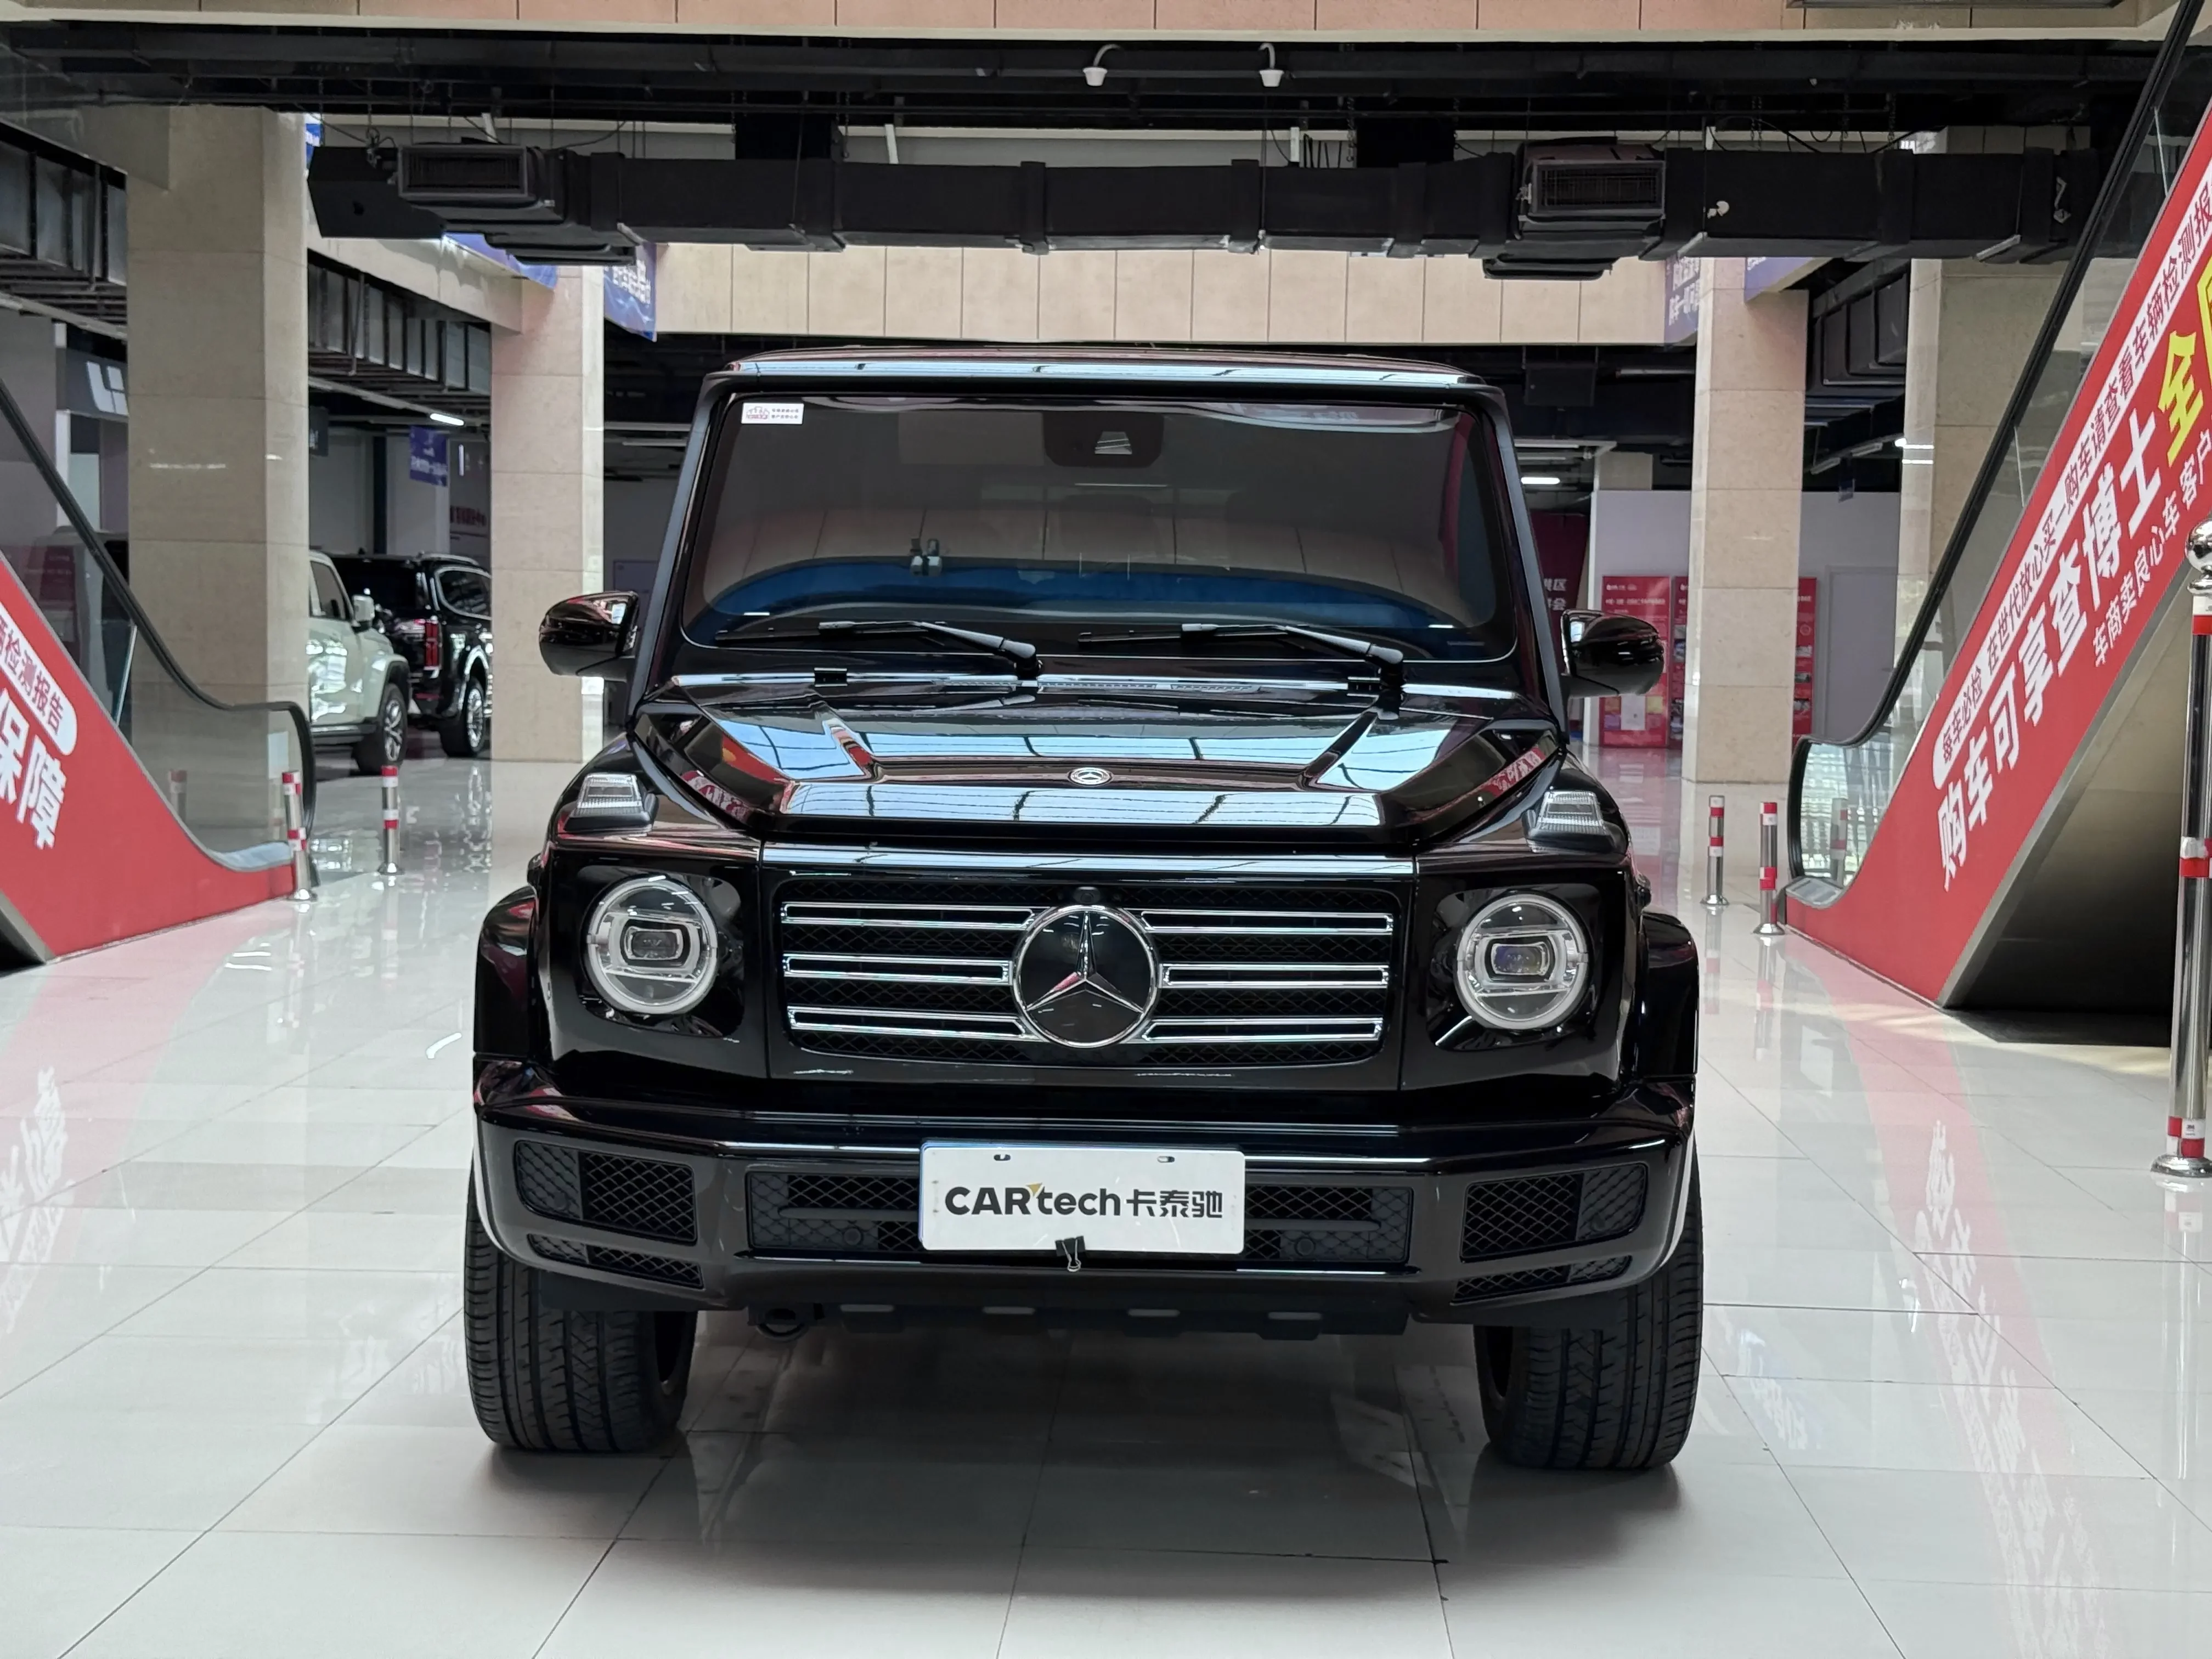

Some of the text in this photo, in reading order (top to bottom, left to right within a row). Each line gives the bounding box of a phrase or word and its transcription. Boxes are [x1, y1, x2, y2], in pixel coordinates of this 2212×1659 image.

[1937, 257, 2212, 891] 购车可享查博士全
[1943, 665, 1983, 763] 每车必检
